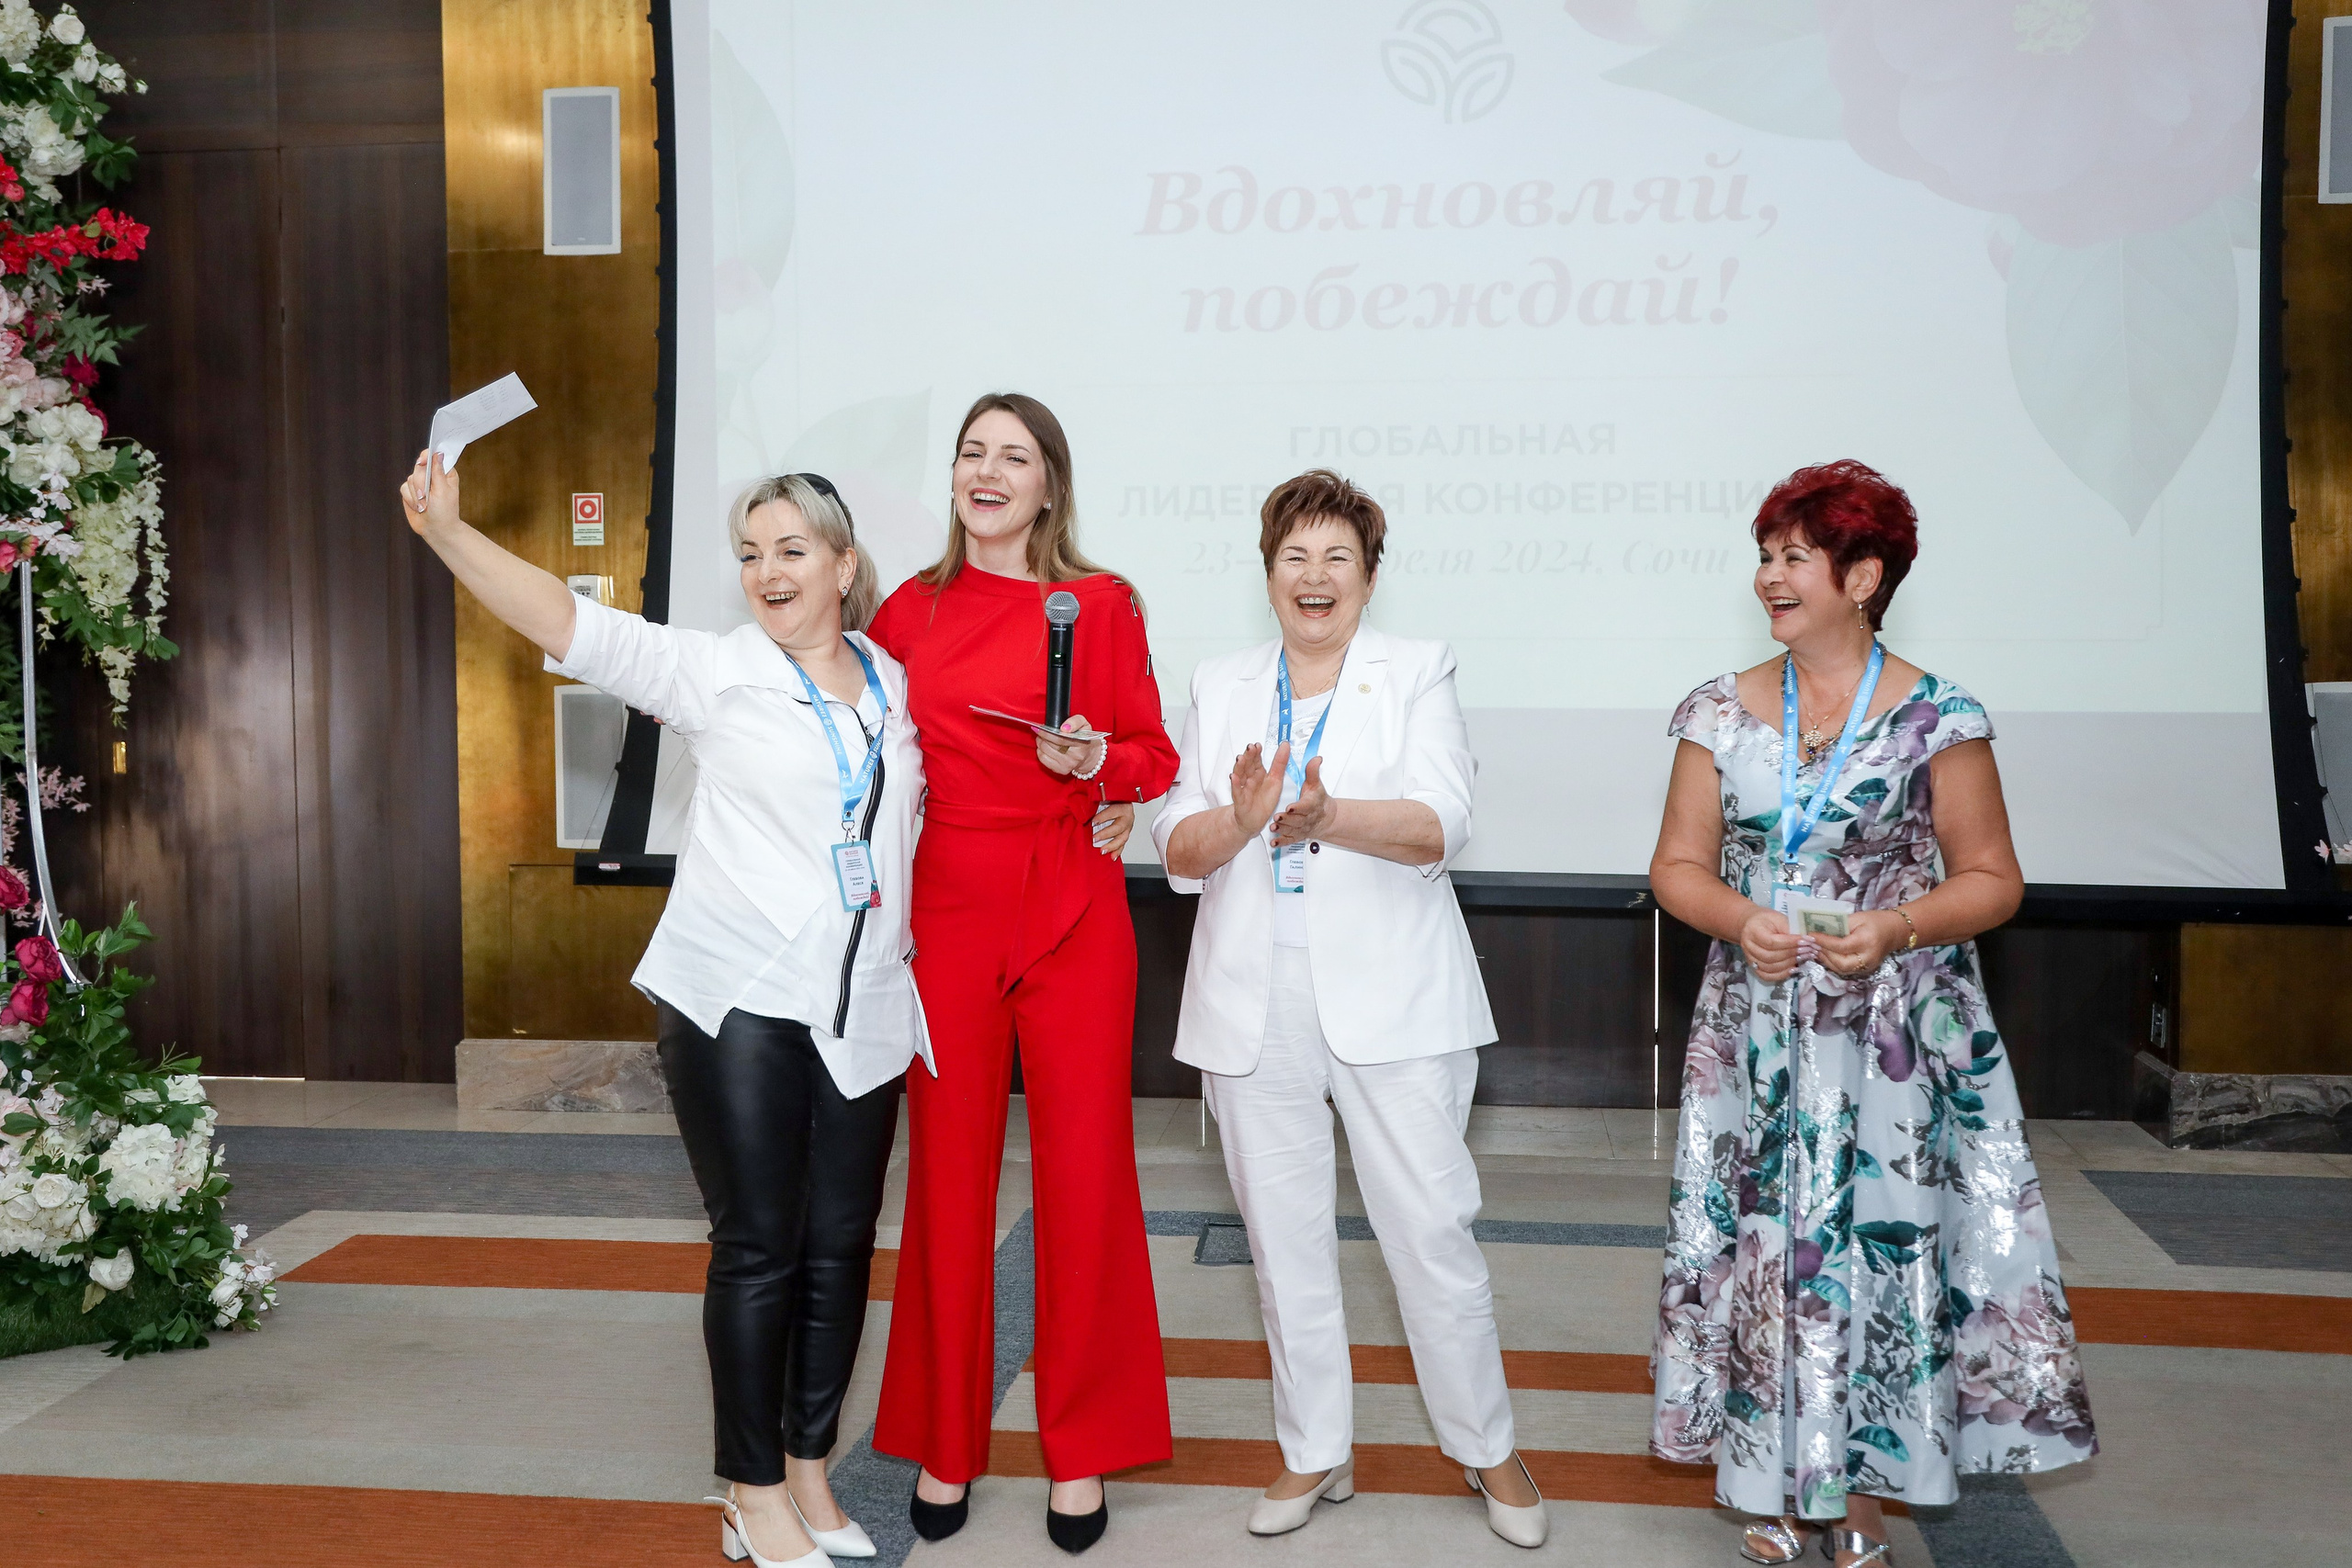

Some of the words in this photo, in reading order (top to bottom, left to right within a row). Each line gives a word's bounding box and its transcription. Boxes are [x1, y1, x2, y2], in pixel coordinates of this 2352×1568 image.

[1134, 150, 1779, 239] Вдохновляй,
[1181, 252, 1740, 333] побеждай!
[1289, 423, 1617, 458] ГЛОБАЛЬНАЯ
[1117, 482, 1406, 523] ЛИДЕРЯ
[1425, 479, 1765, 520] КОНФЕРЕНЦИ
[1380, 543, 1476, 581] реля
[1622, 538, 1730, 576] Сочи
[827, 725, 842, 756] SUNSHINE
